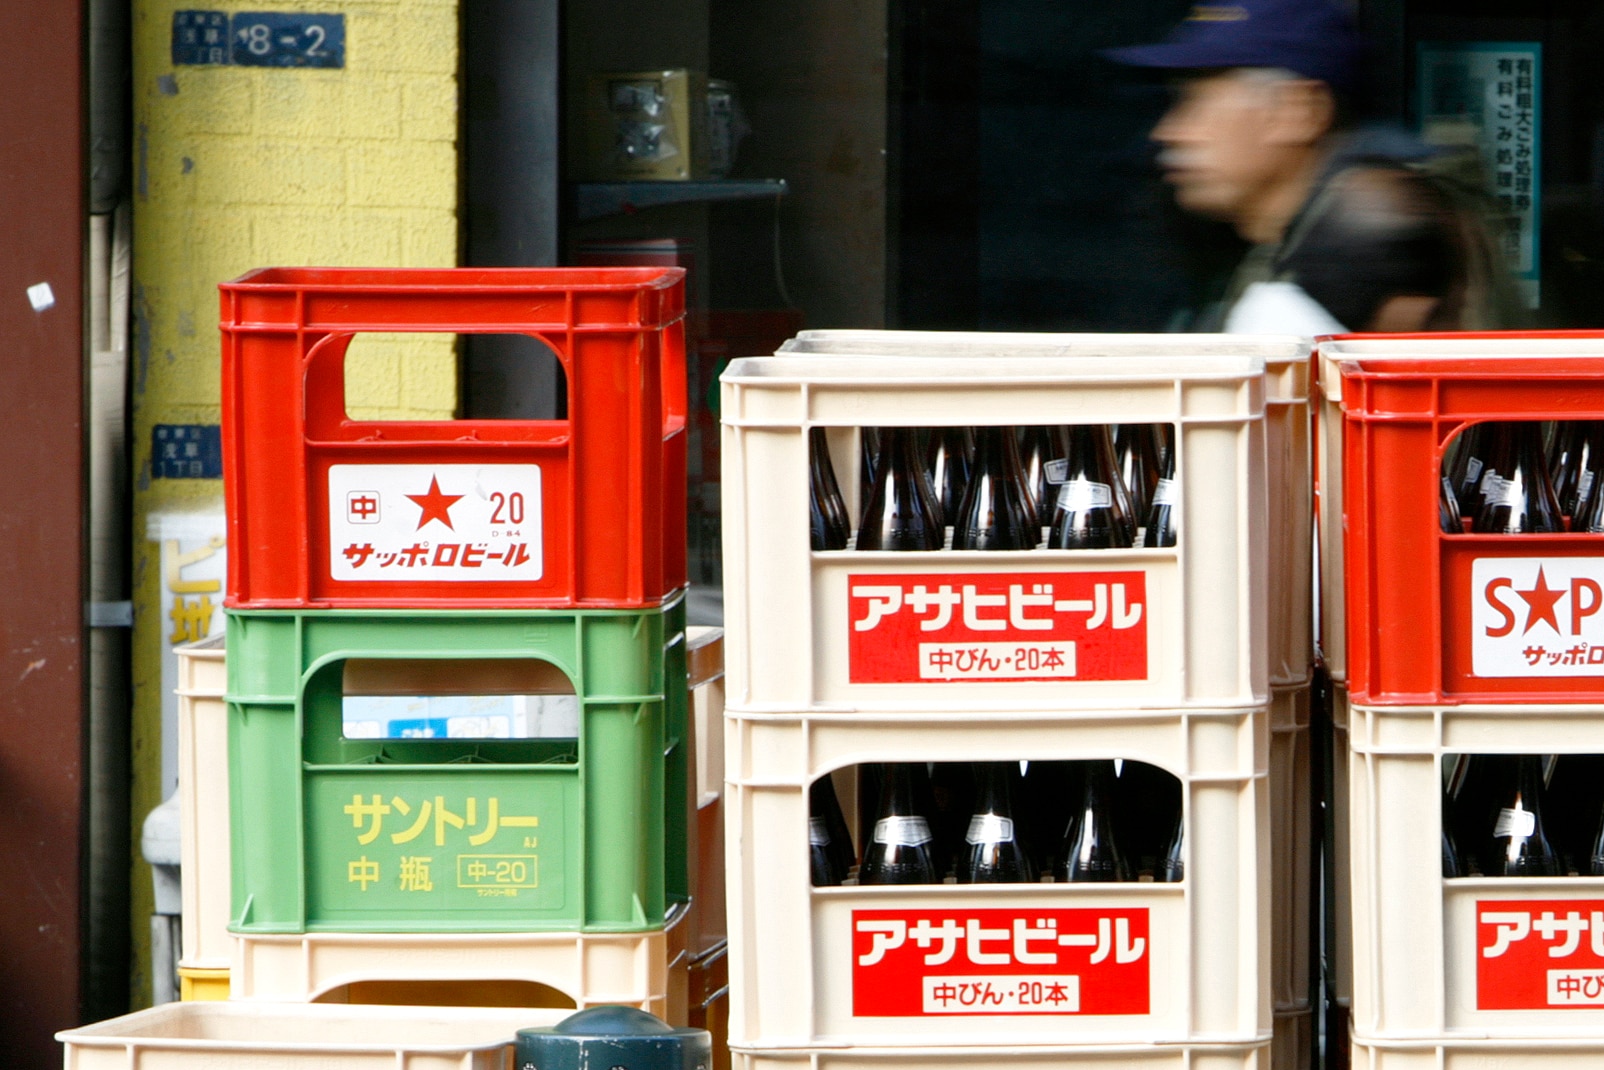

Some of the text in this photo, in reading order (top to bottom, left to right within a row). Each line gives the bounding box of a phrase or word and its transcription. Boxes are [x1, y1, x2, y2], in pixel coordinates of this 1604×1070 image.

[351, 495, 377, 520] 中
[489, 491, 524, 524] 20
[342, 540, 530, 569] サッポロビール
[852, 583, 1142, 632] アサヒビール
[929, 647, 1065, 672] 中びん・20本
[344, 794, 538, 846] サントリー
[856, 917, 1145, 966] アサヒビール
[933, 981, 1068, 1007] 中びん・20本
